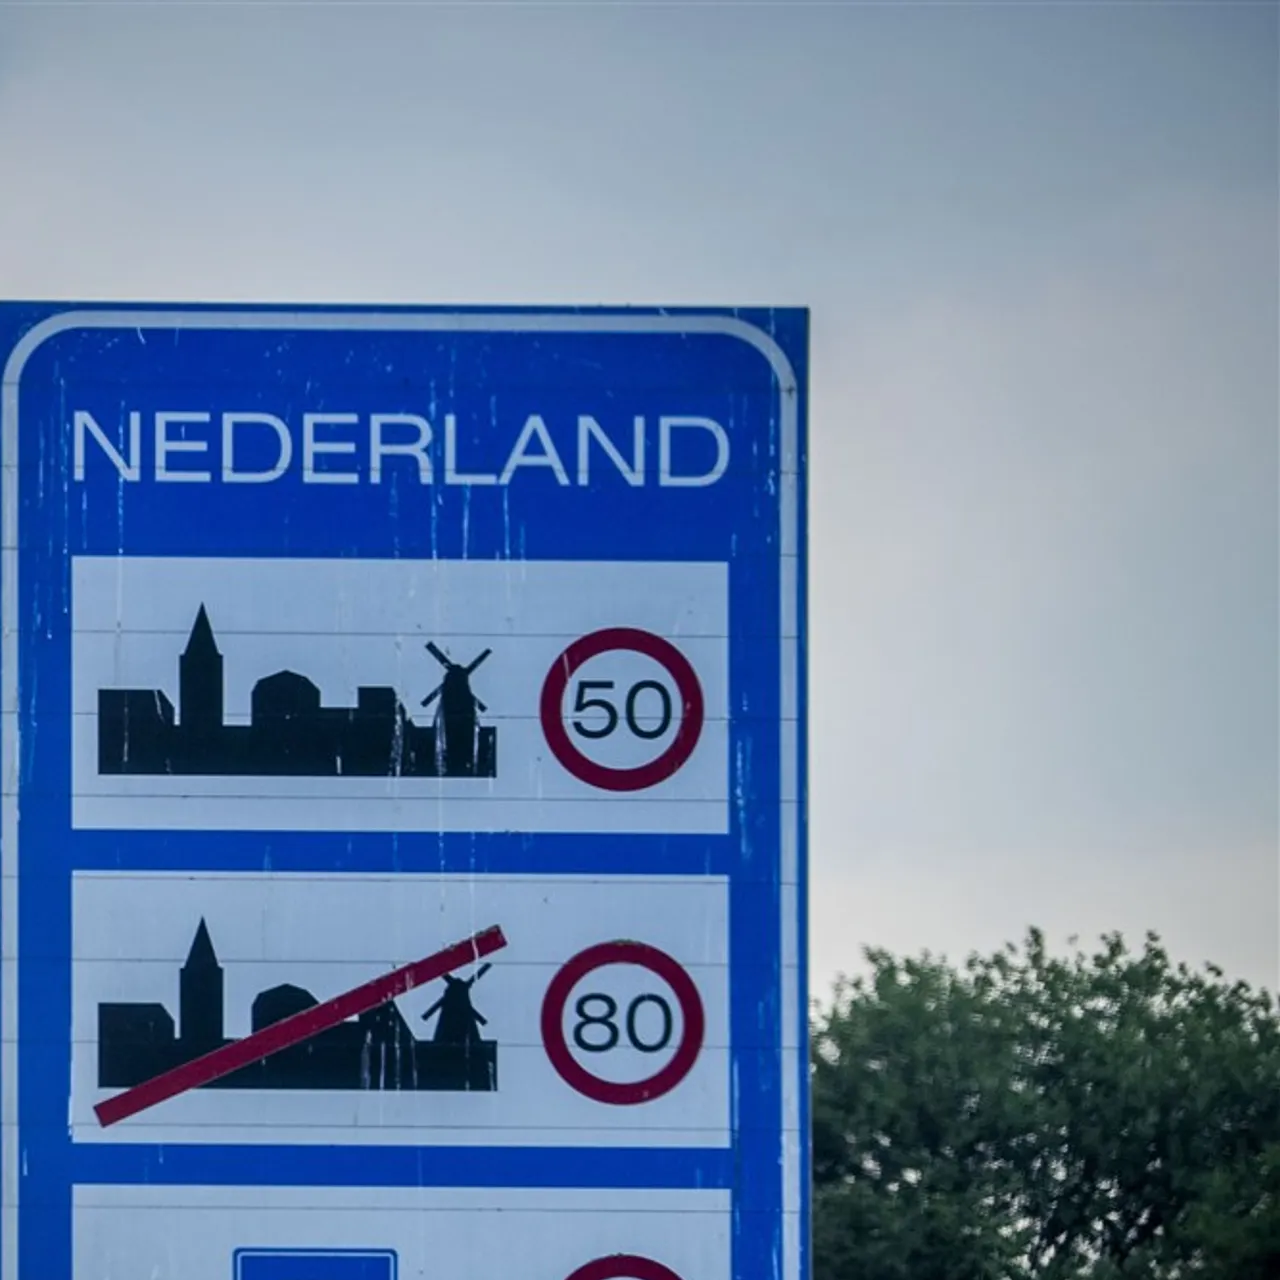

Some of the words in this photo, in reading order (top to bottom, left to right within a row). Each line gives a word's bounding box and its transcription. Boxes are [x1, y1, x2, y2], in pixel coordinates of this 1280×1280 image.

[72, 411, 730, 487] NEDERLAND
[572, 680, 672, 739] 50
[573, 993, 673, 1053] 80
